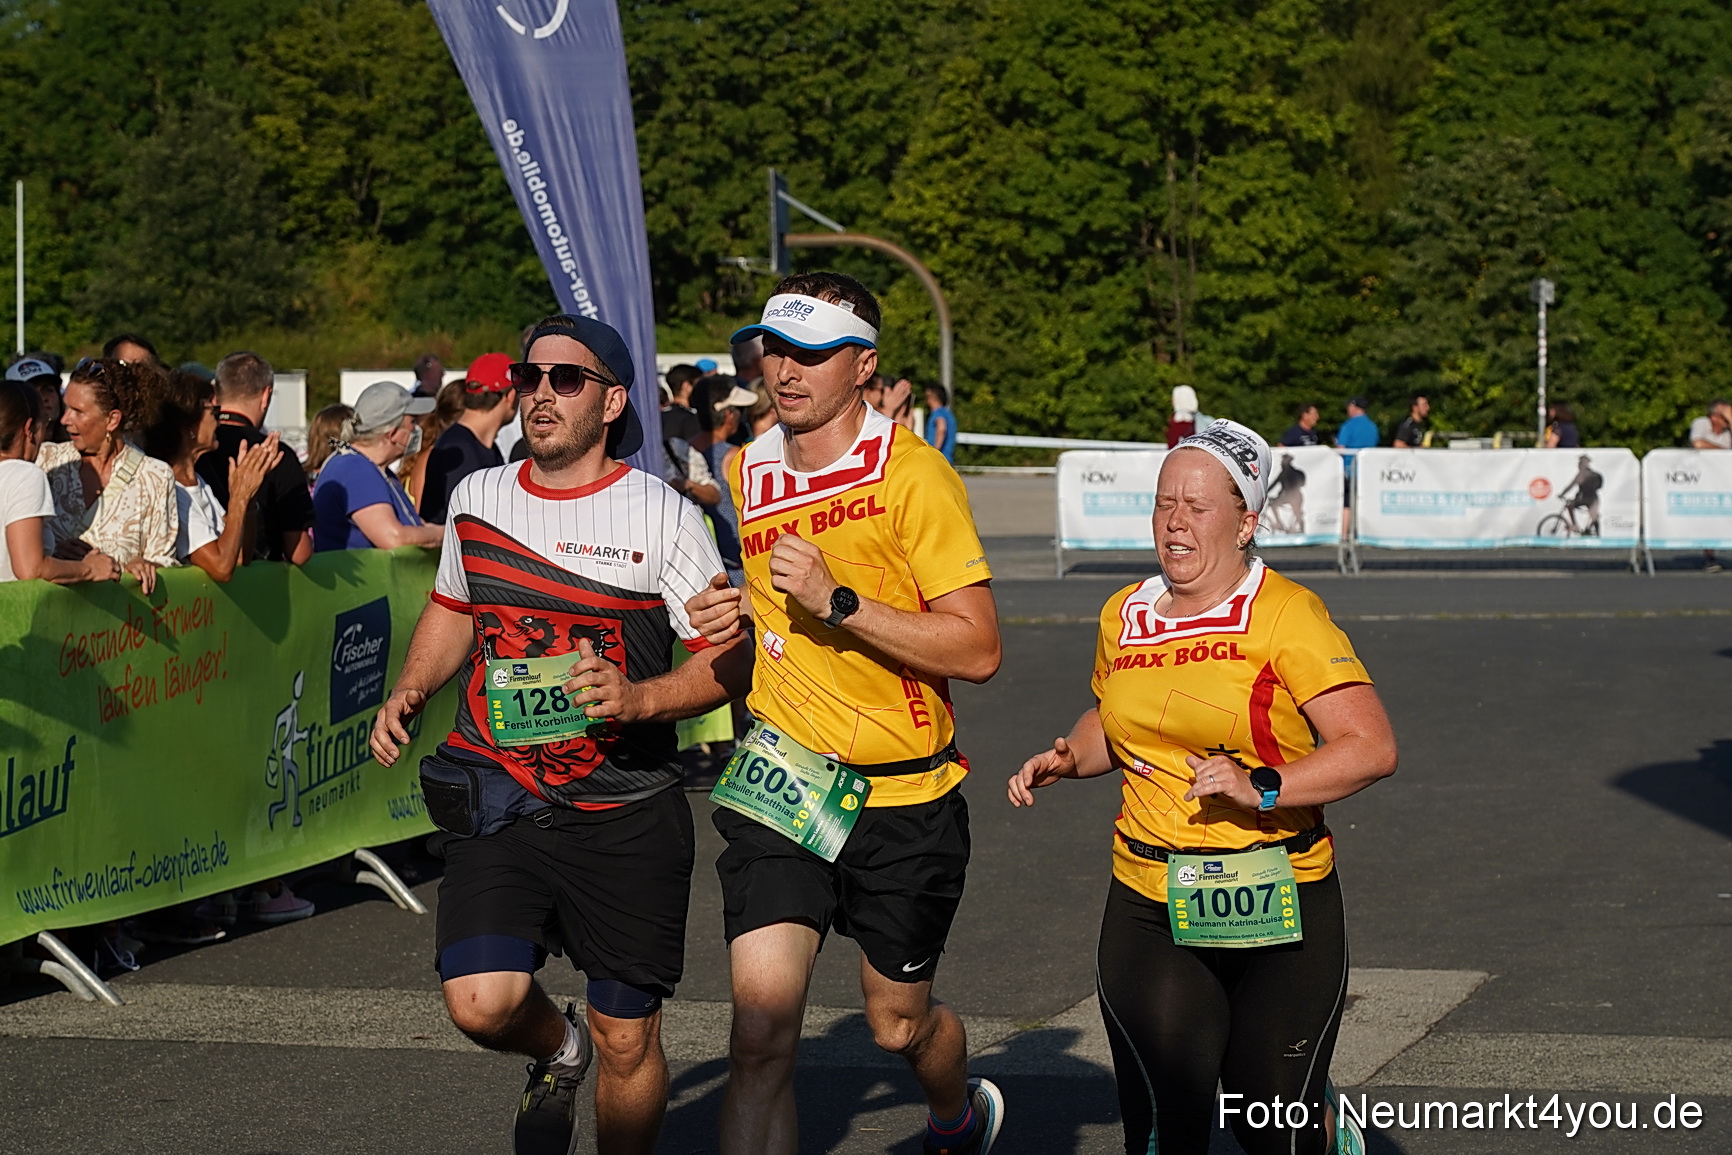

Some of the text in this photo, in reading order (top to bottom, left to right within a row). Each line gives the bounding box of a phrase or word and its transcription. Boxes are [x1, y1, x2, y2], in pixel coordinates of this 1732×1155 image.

[765, 309, 809, 322] SPORTS
[783, 299, 815, 314] ultra
[1380, 470, 1416, 483] NOW
[810, 494, 887, 536] BÖGL
[555, 541, 630, 561] NEUMARKT
[59, 597, 214, 678] Gesunde Firmen
[341, 636, 384, 665] Fischer
[1111, 652, 1169, 673] MAX
[1173, 640, 1247, 666] BÖGL
[98, 631, 227, 725] laufen länger!
[509, 673, 542, 682] Firmenlauf
[493, 700, 506, 730] RUN
[512, 685, 570, 717] 128
[504, 713, 587, 730] Ferstl Korbinian
[0, 735, 77, 830] lauf
[720, 756, 740, 786] RUN
[735, 750, 810, 806] 1605
[308, 771, 361, 816] neumarkt
[725, 777, 757, 798] Schuller
[755, 792, 796, 820] Matthias
[793, 790, 821, 829] 2022
[16, 830, 229, 914] www.firmenlauf-oberpfalz.de
[1199, 871, 1239, 881] Firmenlauf
[1175, 899, 1189, 930] RUN
[1189, 882, 1276, 918] 1007
[1280, 884, 1296, 929] 2022
[1189, 916, 1283, 928] Neumann Katrina-Luisa
